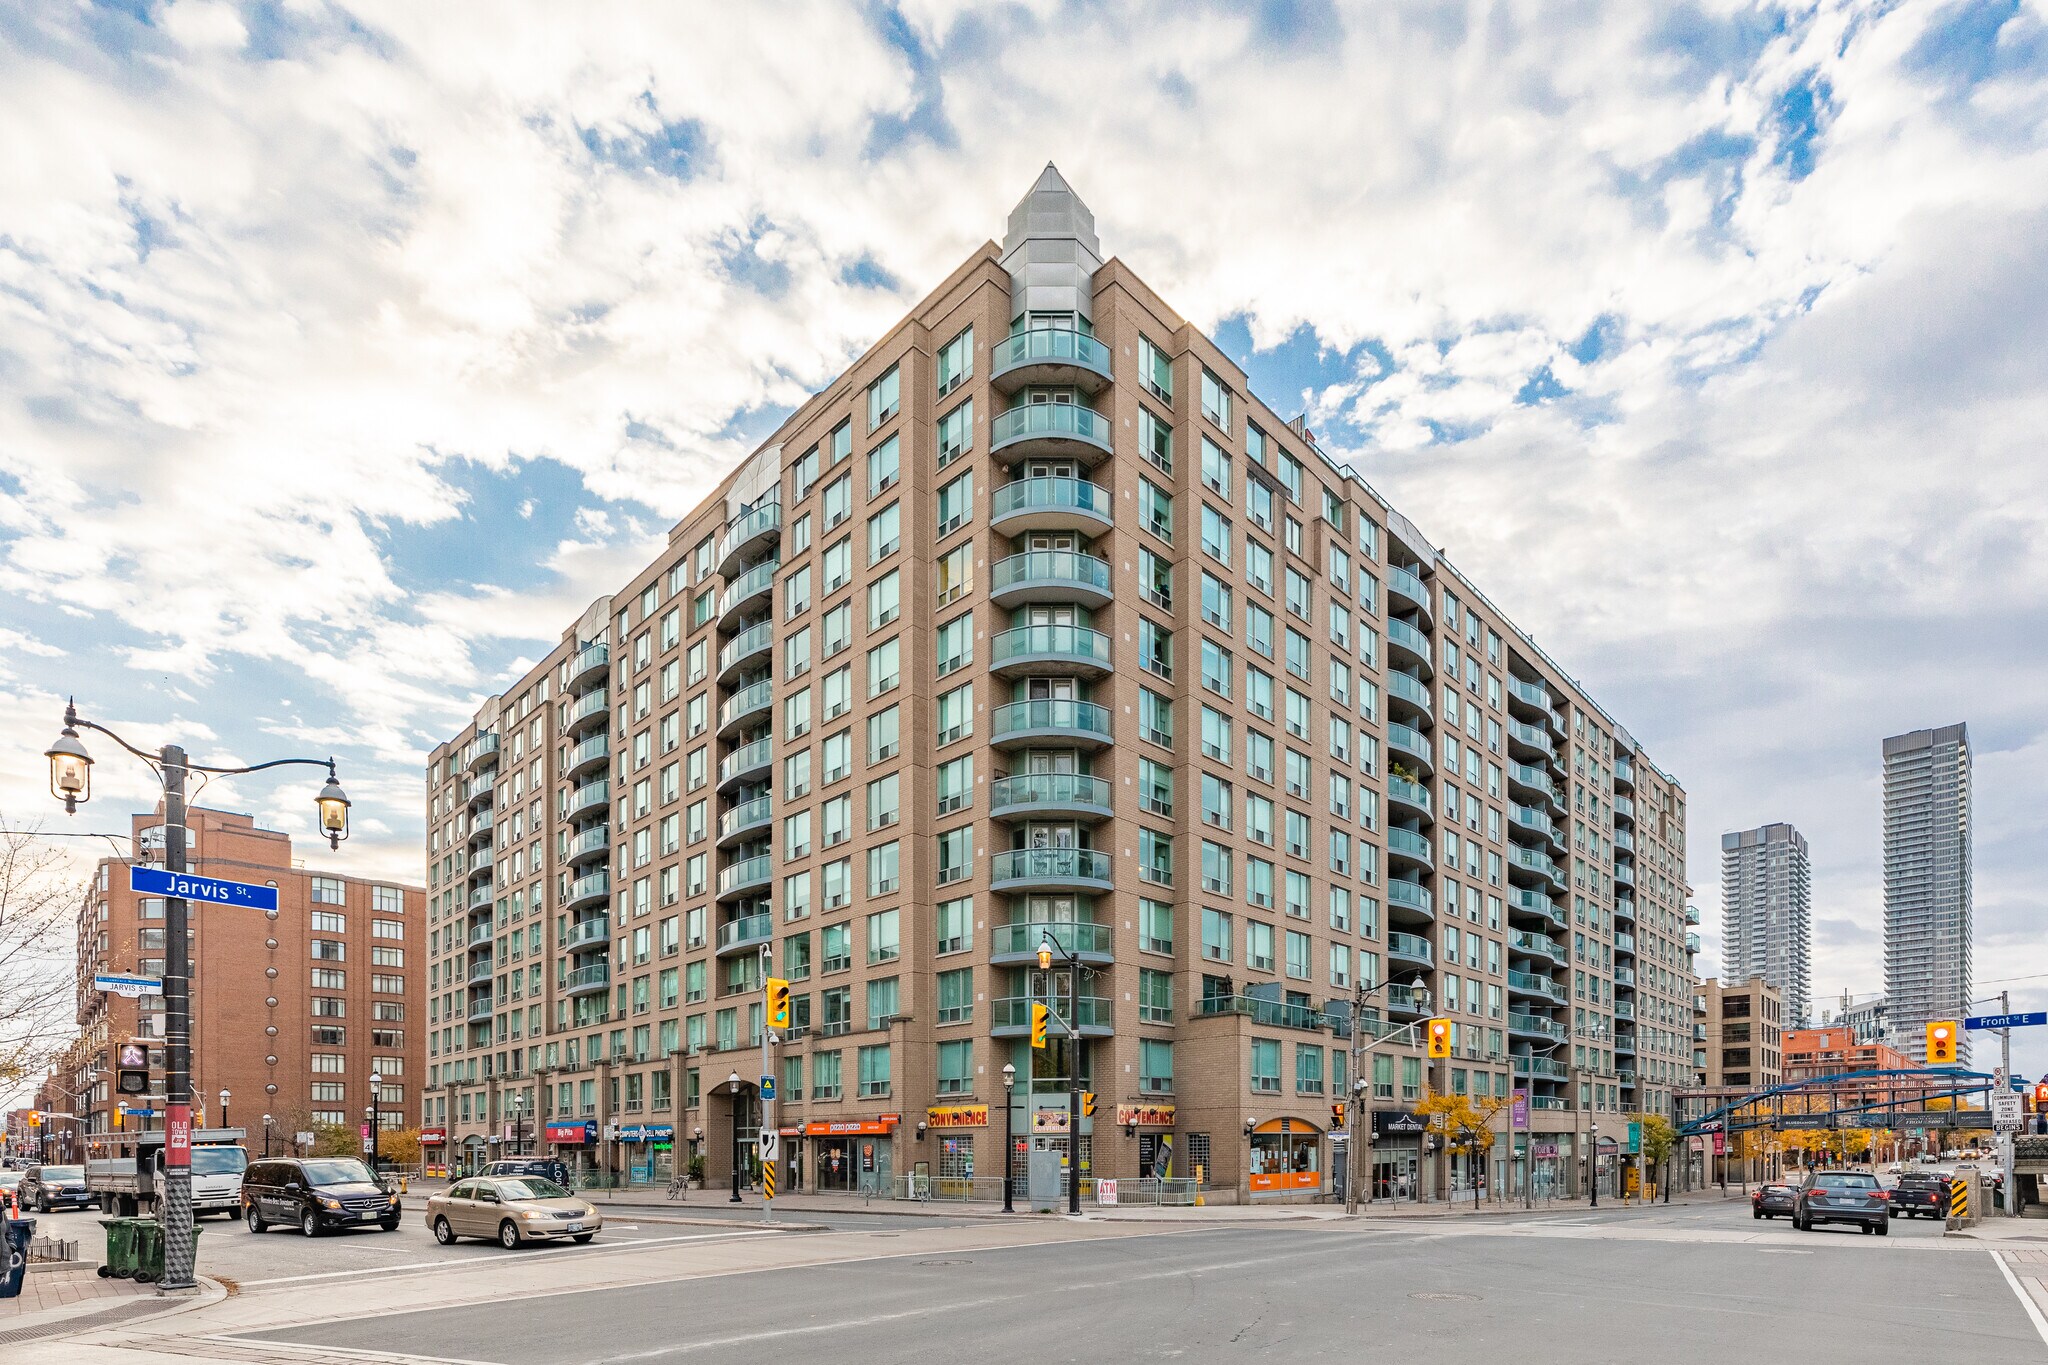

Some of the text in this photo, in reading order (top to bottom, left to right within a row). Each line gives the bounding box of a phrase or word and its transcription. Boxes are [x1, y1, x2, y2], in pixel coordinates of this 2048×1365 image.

[166, 876, 252, 900] Jarvis St.
[1980, 1016, 2010, 1026] Front
[2022, 1014, 2029, 1023] E
[171, 1121, 187, 1129] OLD
[929, 1111, 987, 1127] CONVENIENCE
[564, 1128, 573, 1136] Pita
[829, 1123, 845, 1133] pizza
[845, 1123, 861, 1132] pizza
[1099, 1182, 1116, 1194] ATM
